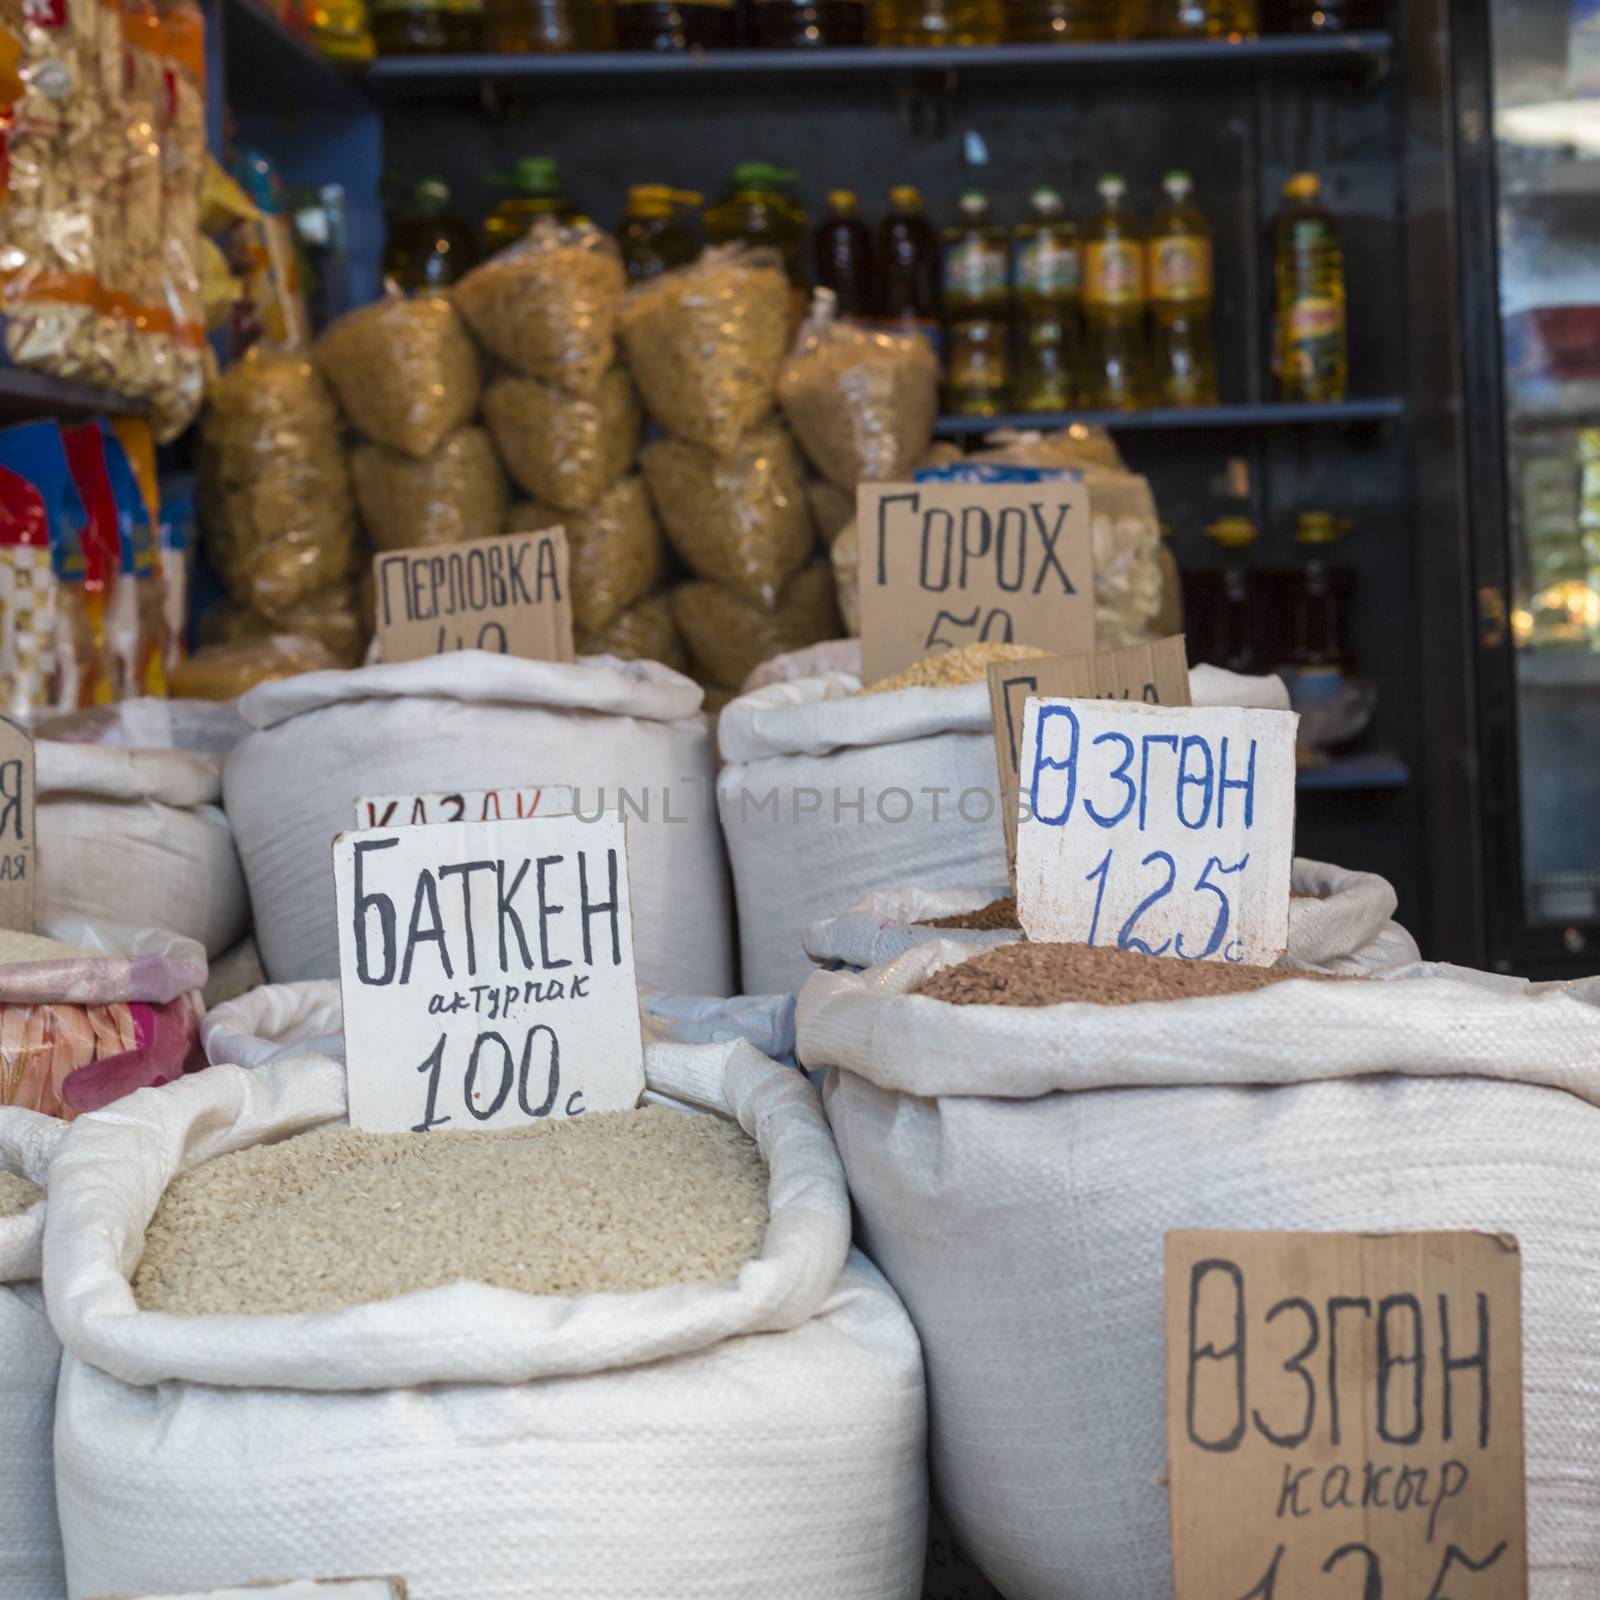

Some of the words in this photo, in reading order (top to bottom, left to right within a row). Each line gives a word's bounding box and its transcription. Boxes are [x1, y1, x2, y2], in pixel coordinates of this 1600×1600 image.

[381, 538, 561, 625] ПЕРЛОВКА
[877, 492, 1077, 595] ГОРОХ
[353, 838, 621, 986] БАТКЕН
[428, 975, 590, 1020] актурпак
